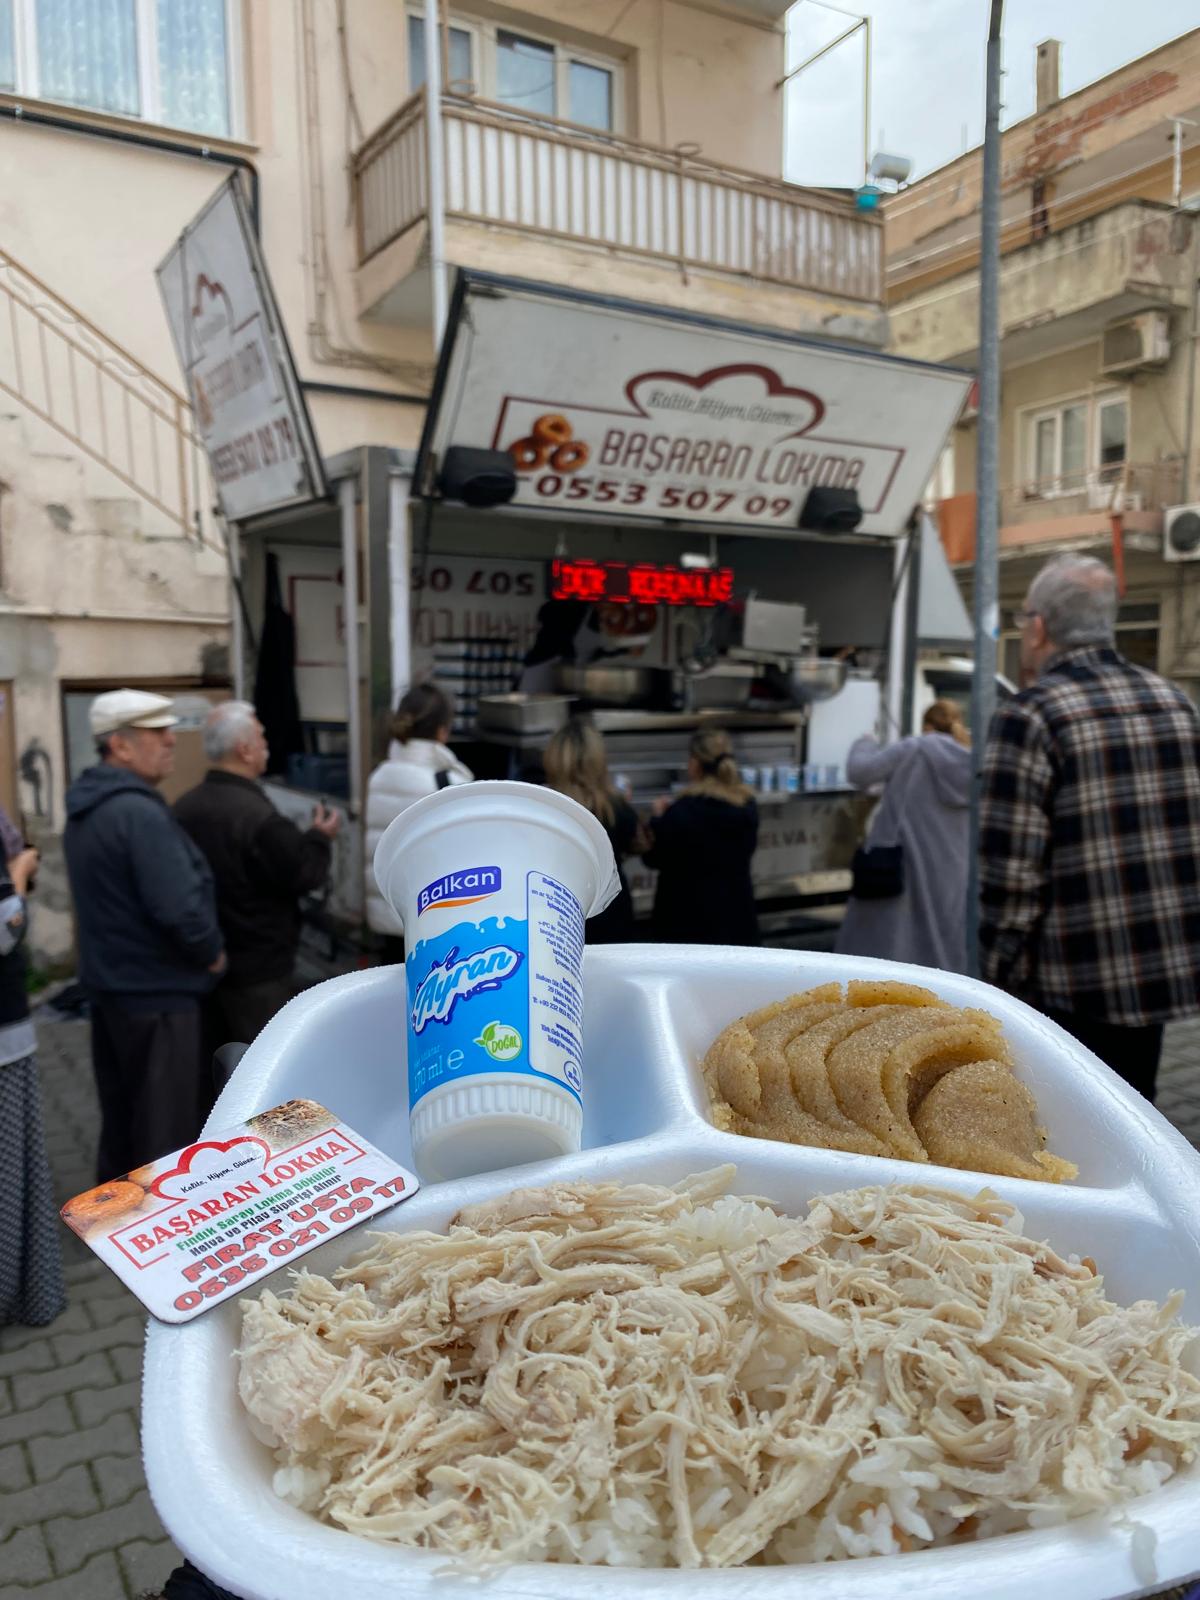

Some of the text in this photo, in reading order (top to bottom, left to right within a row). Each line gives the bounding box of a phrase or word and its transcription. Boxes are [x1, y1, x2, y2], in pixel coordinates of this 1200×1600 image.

[599, 429, 865, 490] BAŞARAN LOKMA
[536, 475, 793, 518] 0553 507 09
[421, 871, 495, 909] Balkan
[415, 951, 513, 1027] Ayran
[491, 1034, 520, 1054] DOĞAL
[129, 1141, 349, 1254] BAŞARAN LOKMA
[216, 1206, 255, 1230] Saray
[254, 1187, 295, 1211] Lokma
[292, 1164, 338, 1192] Dökülür
[173, 1176, 406, 1311] 0535 021 09 17
[181, 1176, 377, 1283] FIRAT USTA
[190, 1234, 226, 1257] Helva
[225, 1225, 241, 1239] ve
[240, 1210, 271, 1231] Pilav
